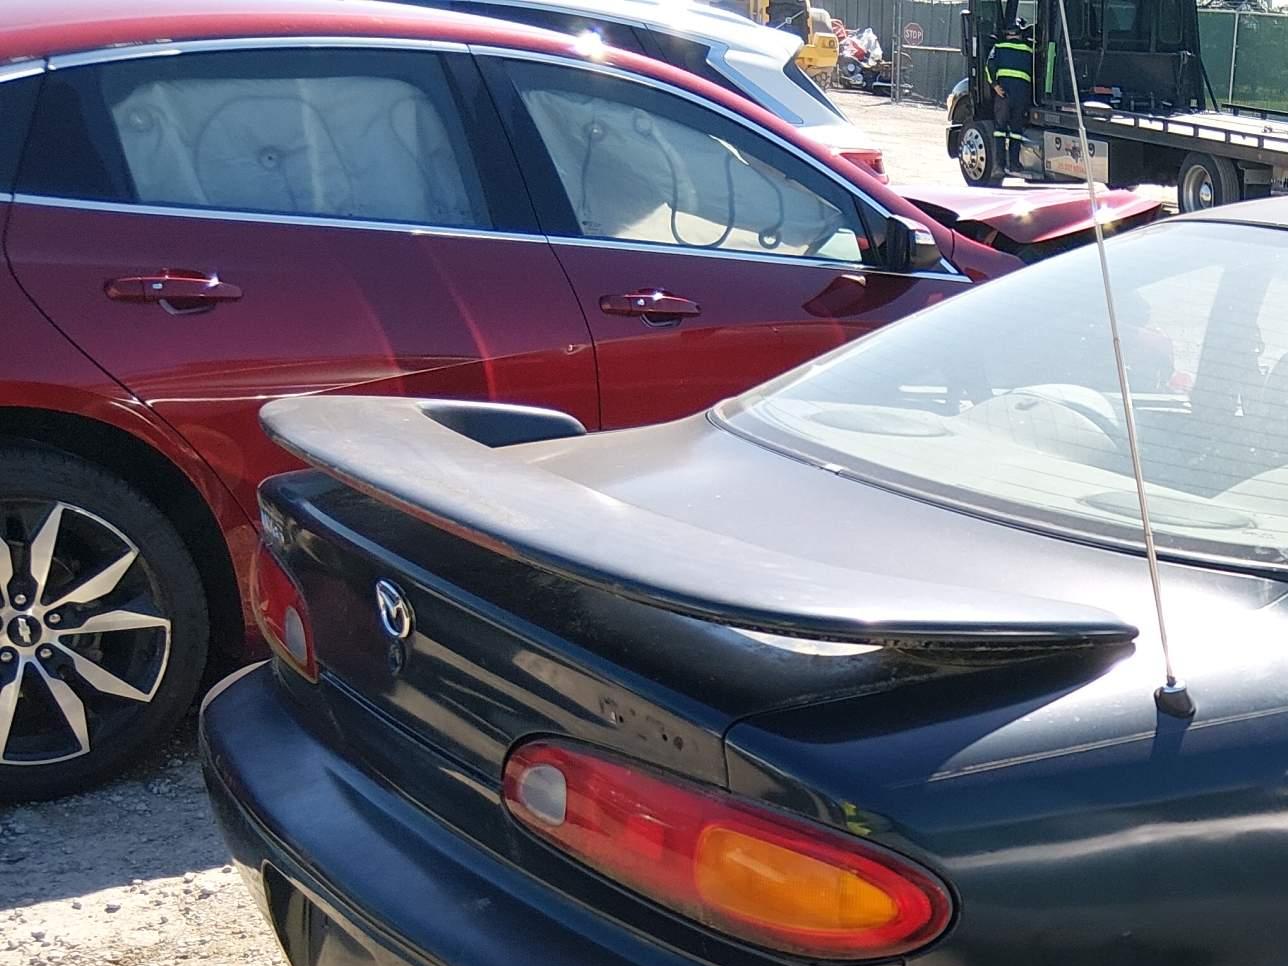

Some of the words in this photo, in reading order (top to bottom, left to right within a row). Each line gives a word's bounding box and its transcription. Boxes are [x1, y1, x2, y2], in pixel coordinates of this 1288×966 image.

[905, 29, 921, 39] STOP
[1055, 137, 1062, 151] 9
[1088, 143, 1095, 157] 9
